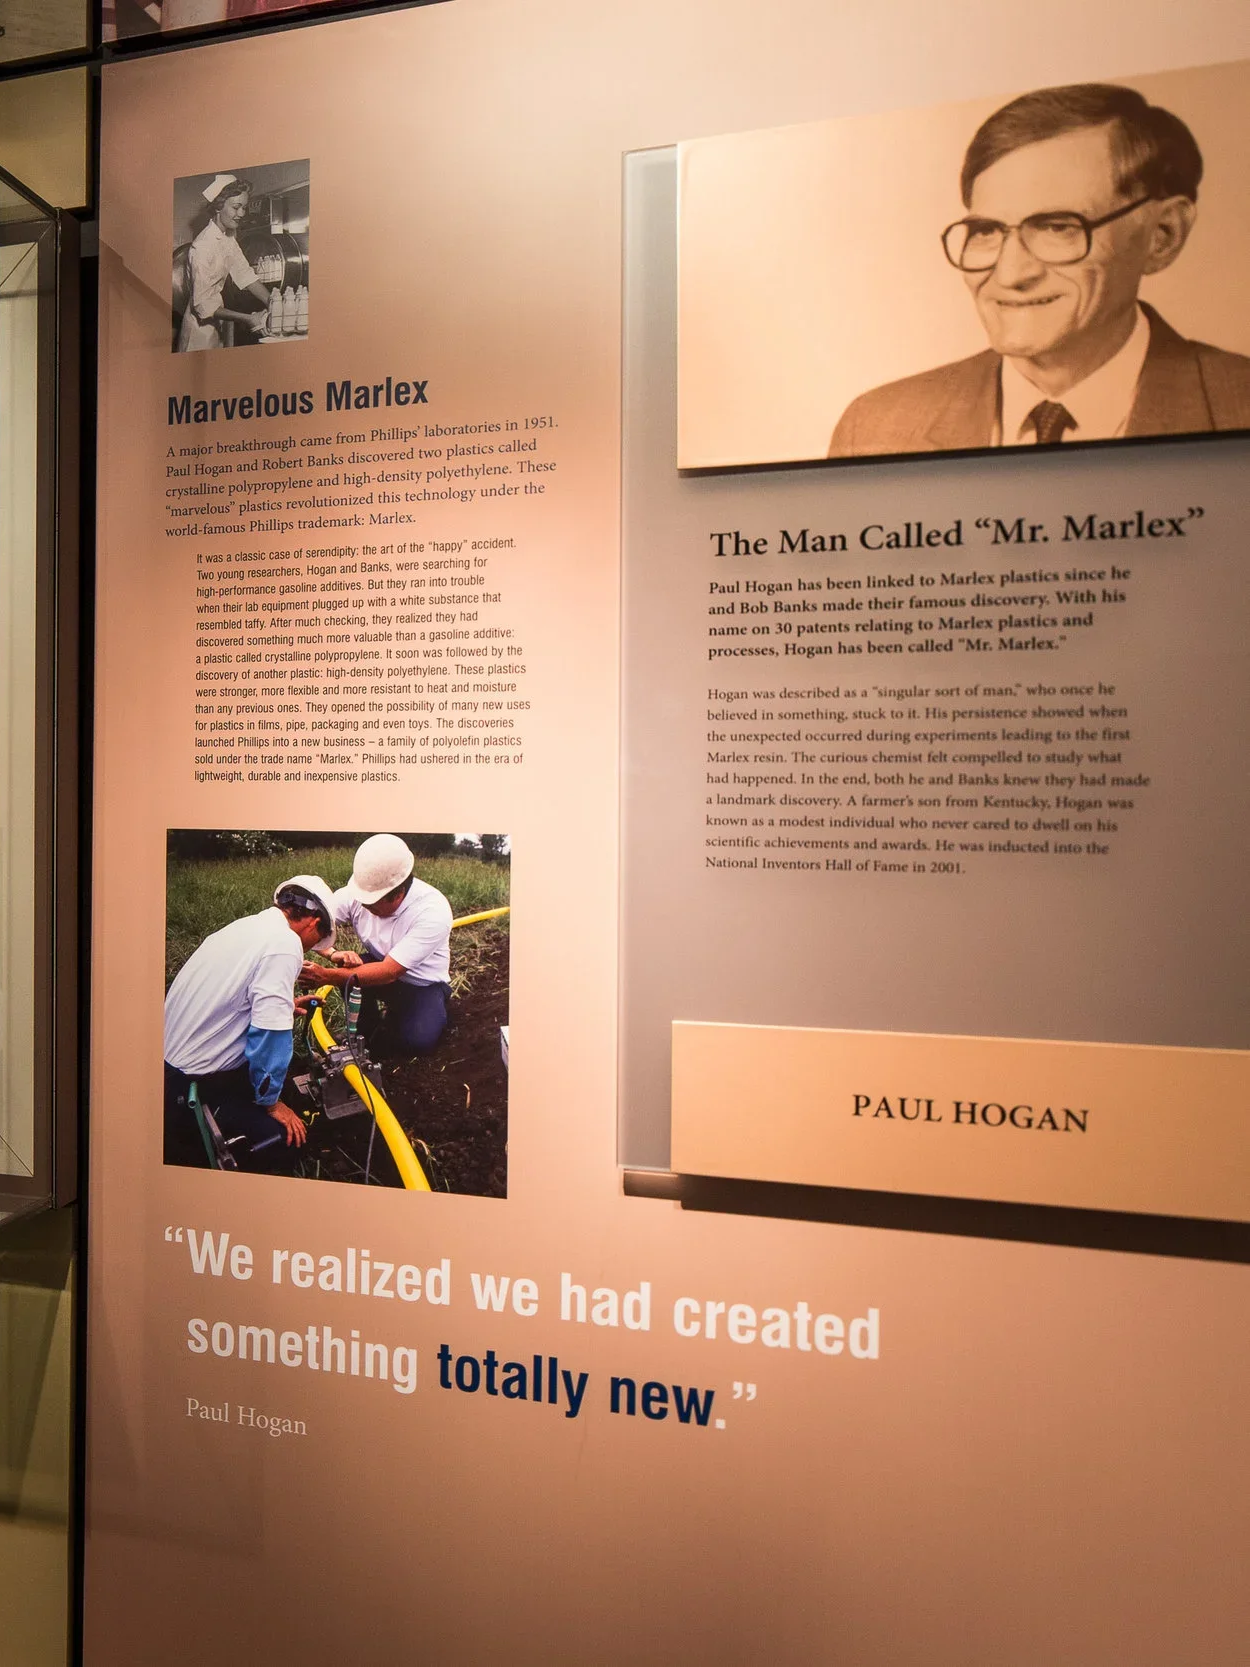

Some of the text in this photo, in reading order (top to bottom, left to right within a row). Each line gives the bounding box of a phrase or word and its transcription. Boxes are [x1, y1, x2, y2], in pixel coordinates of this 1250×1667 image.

[168, 376, 429, 426] Marvelous Marlex
[165, 445, 176, 458] A
[179, 444, 214, 459] major
[216, 435, 297, 454] breakthrough
[299, 436, 333, 448] came
[335, 431, 366, 445] from
[424, 420, 501, 438] laboratories
[505, 419, 518, 432] in
[524, 415, 559, 430] 1951.
[709, 530, 768, 557] The
[777, 528, 848, 554] Man
[859, 519, 964, 551] Called
[709, 565, 1131, 597] Paul Hogan has been linked to Marlex plastics since he
[194, 770, 401, 784] lightweight, durable and inexpensive plastics.
[705, 856, 966, 875] National Inventors Hall of Fame in 2001.
[853, 1094, 1089, 1133] PAUL HOGAN
[164, 1225, 880, 1360] “We realized we had created
[187, 1318, 418, 1395] something
[437, 1344, 589, 1418] totally
[186, 1397, 308, 1438] Paul Hogan
